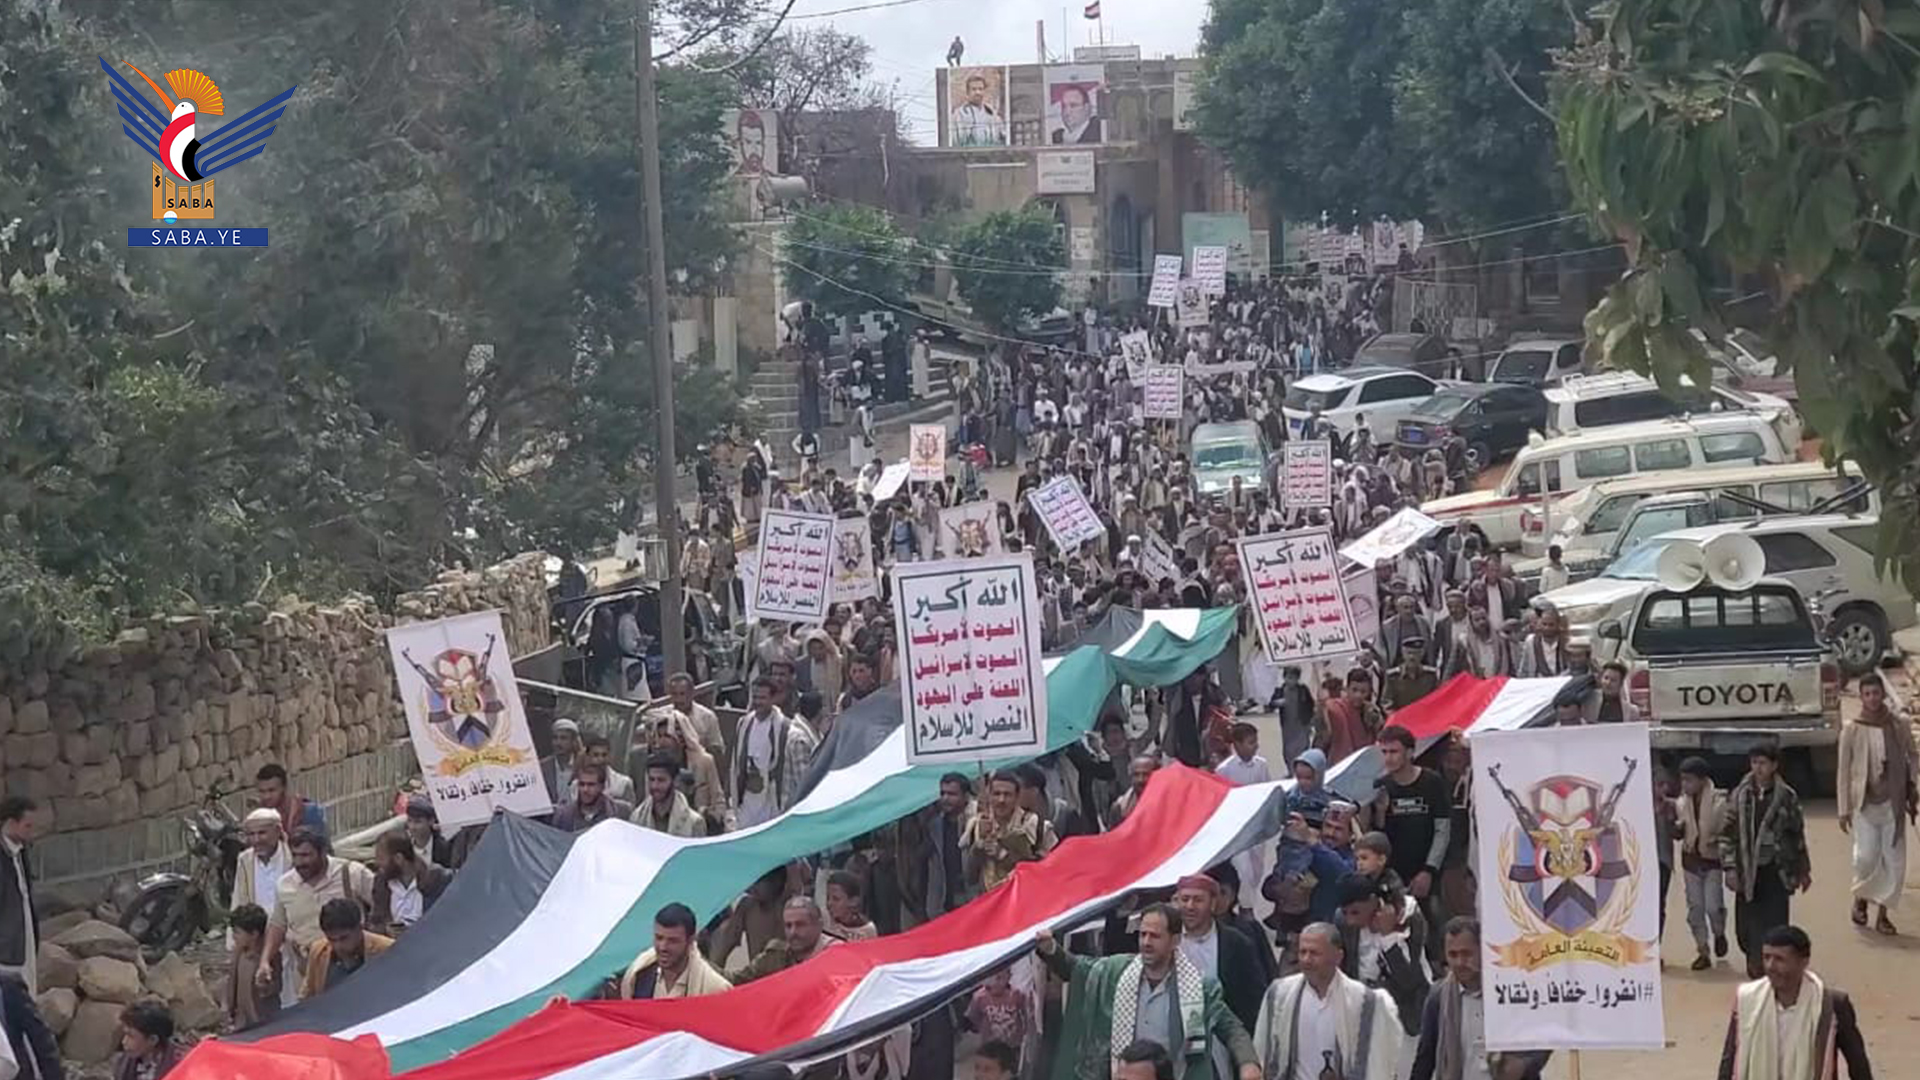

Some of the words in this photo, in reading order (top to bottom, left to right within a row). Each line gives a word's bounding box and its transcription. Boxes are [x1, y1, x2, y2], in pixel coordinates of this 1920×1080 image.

[1300, 539, 1329, 561] الله
[909, 576, 973, 622] أكبر
[976, 576, 1019, 607] الله
[911, 619, 969, 648] لأمريكا
[973, 616, 1021, 642] الموت
[975, 648, 1024, 673] الموت
[916, 684, 957, 710] اليهود
[961, 681, 984, 706] على
[989, 678, 1026, 699] اللعنة
[1677, 682, 1795, 706] TOYOTA
[918, 711, 974, 747] للإسلام
[980, 703, 1029, 741] النصر
